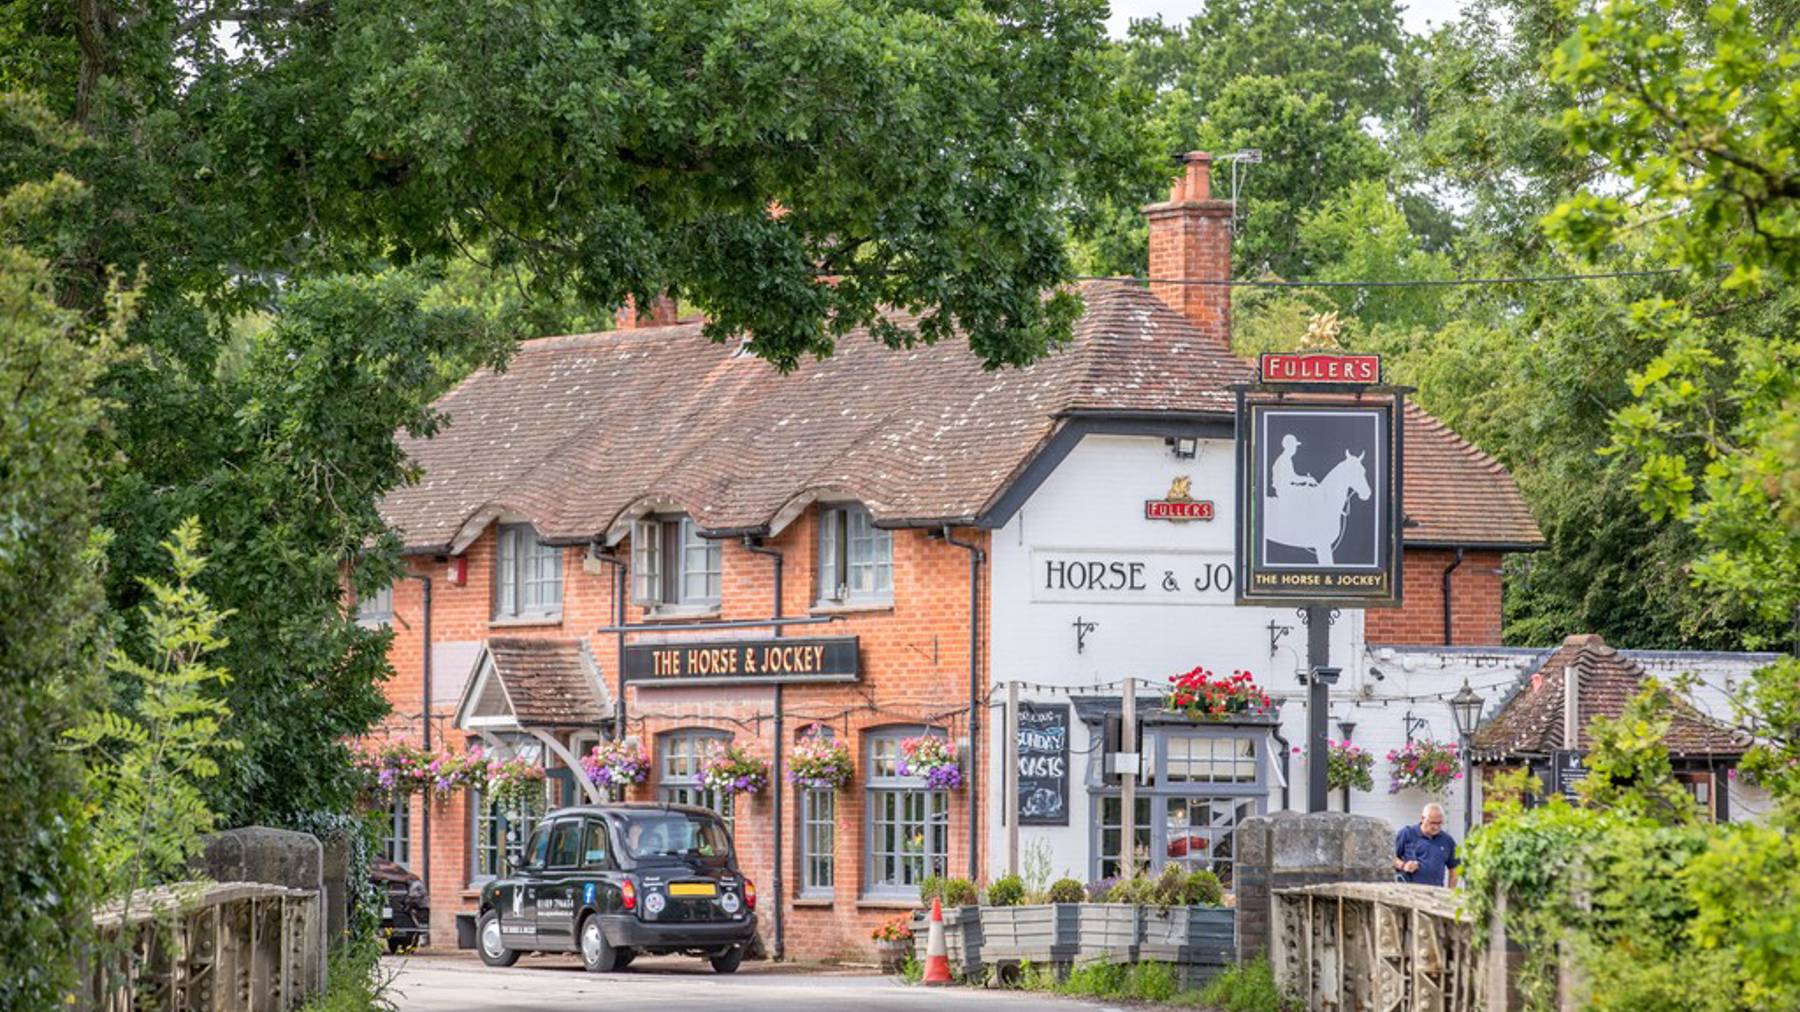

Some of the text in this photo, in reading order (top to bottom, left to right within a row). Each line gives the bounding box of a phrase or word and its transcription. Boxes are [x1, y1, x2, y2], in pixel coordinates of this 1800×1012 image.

[1270, 358, 1372, 378] FULLER'S
[1045, 560, 1147, 590] HORSE
[1161, 571, 1181, 591] &
[1255, 574, 1381, 586] THE HORSE & JOCKEY
[653, 646, 824, 675] THE HORSE & JOCKEY
[1018, 755, 1064, 778] OASTS
